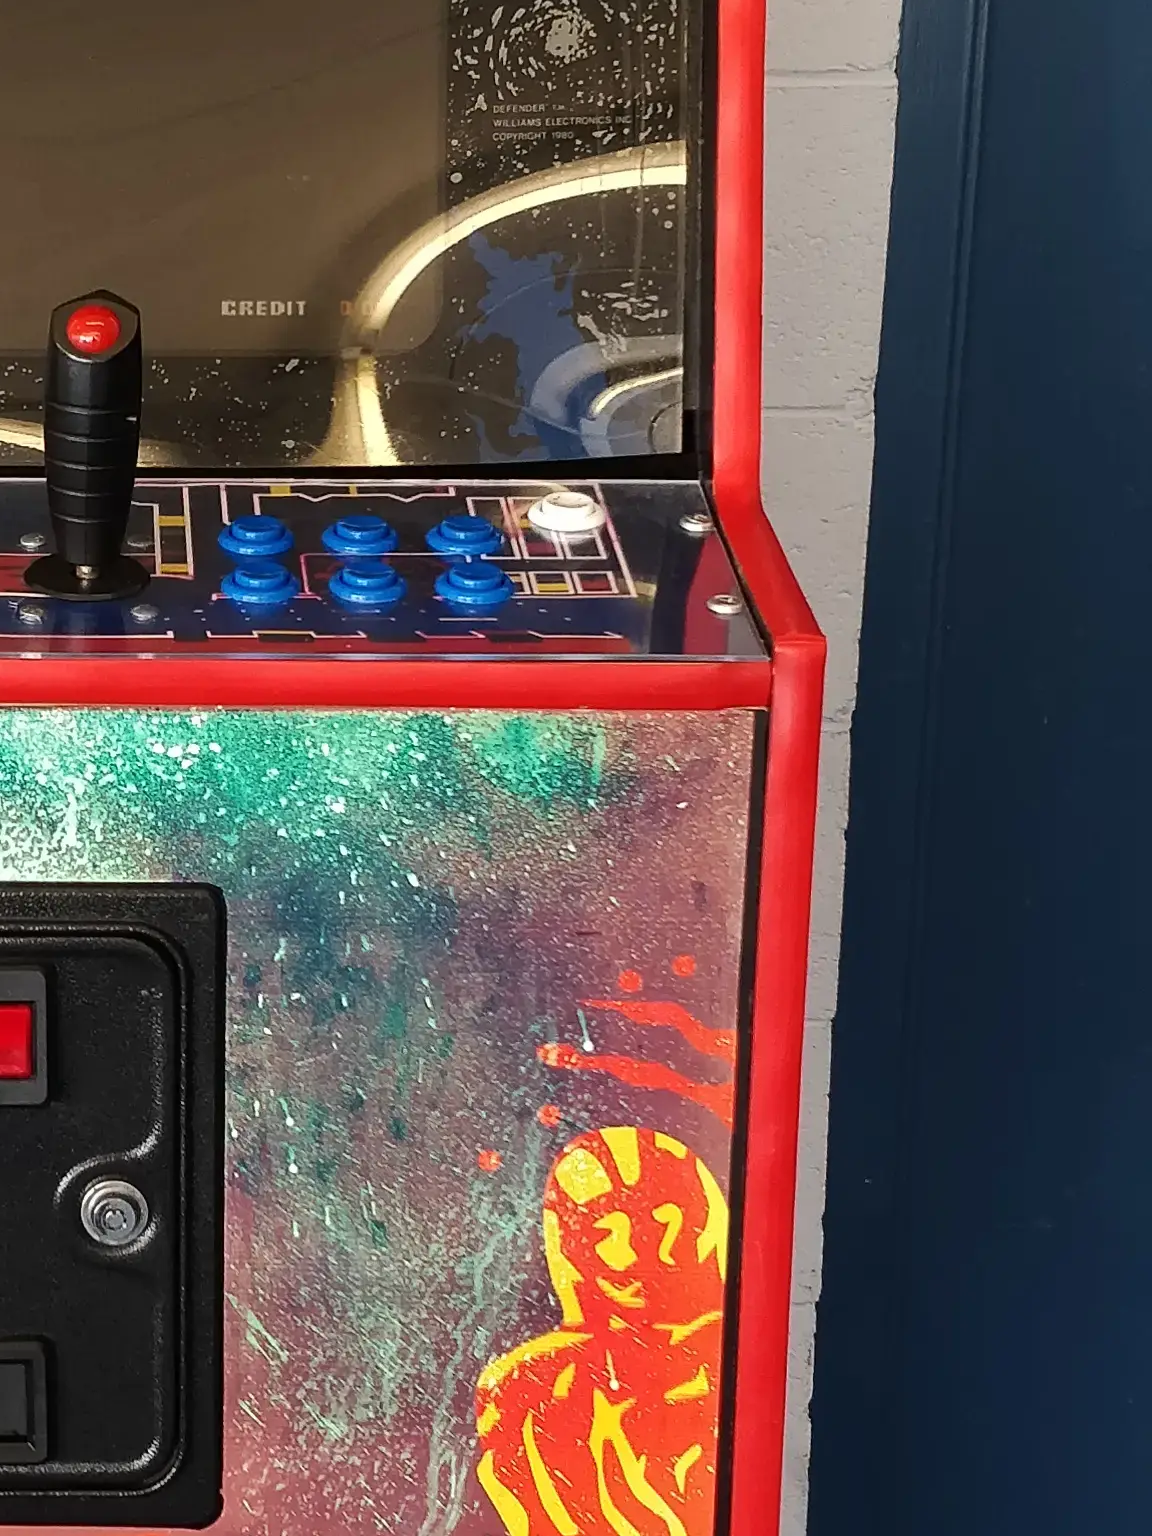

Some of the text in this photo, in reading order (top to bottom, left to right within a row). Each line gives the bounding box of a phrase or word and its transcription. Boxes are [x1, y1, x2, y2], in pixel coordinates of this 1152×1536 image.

[492, 104, 546, 114] DEFENDER
[492, 118, 542, 128] WILLIAMS
[545, 116, 612, 126] ELECTRONICS
[492, 131, 575, 141] COPYRIGHT 1980
[221, 300, 306, 316] CREDIT
